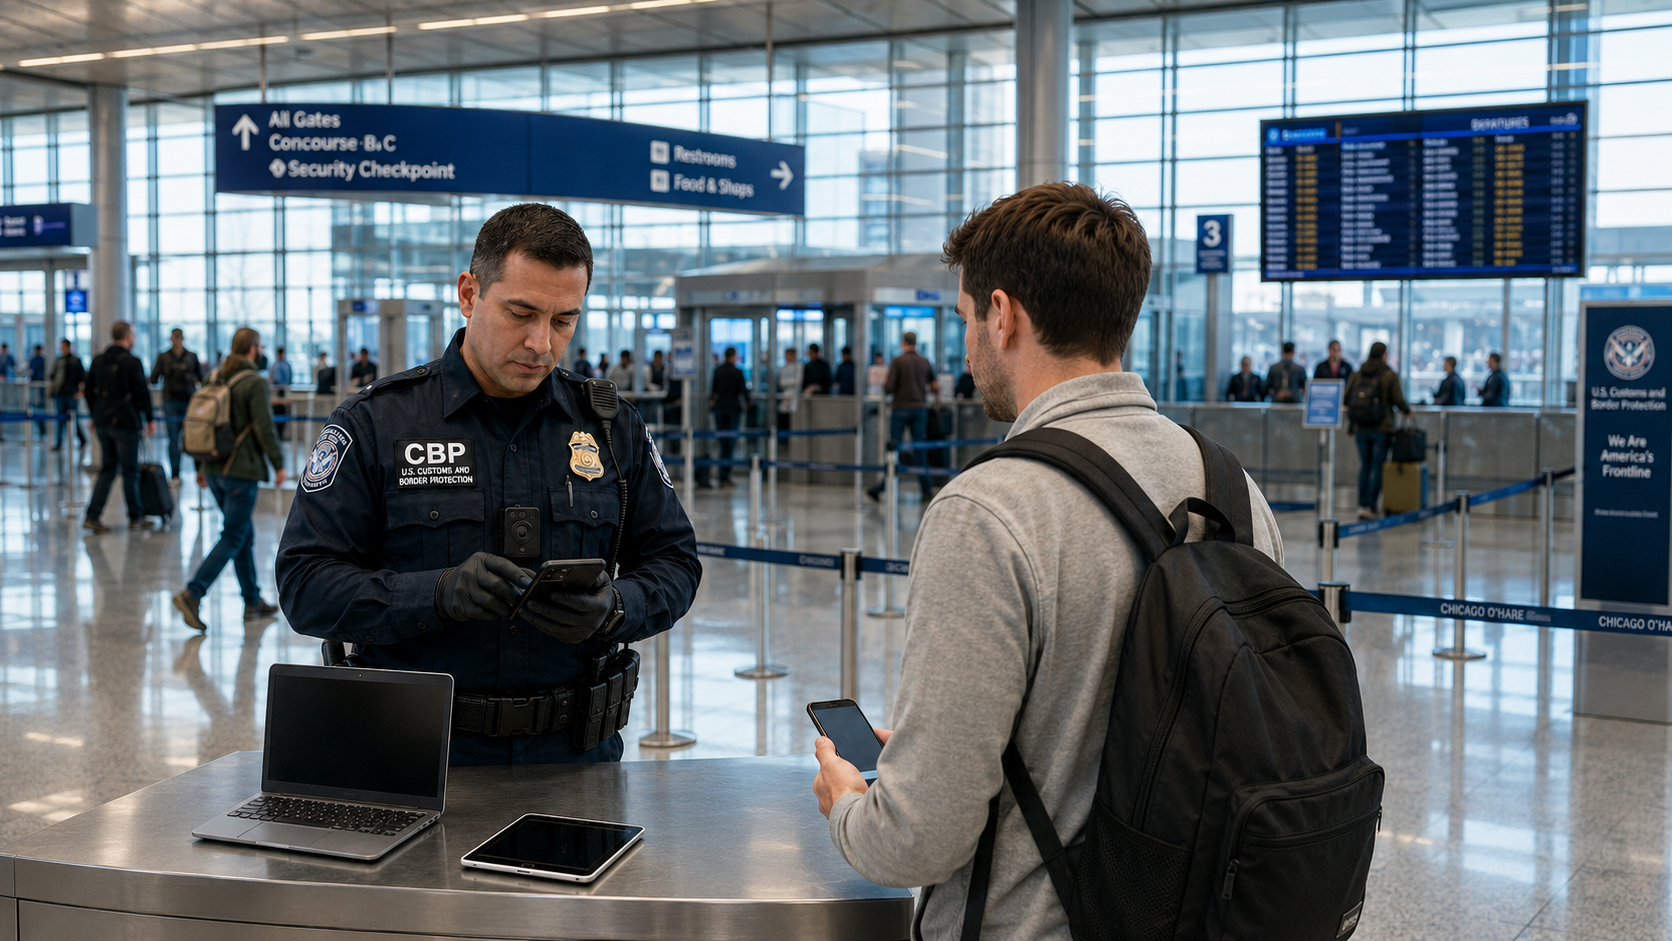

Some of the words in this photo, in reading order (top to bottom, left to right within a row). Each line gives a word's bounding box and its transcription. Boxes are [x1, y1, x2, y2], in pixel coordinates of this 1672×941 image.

[268, 110, 290, 128] All
[293, 110, 341, 129] Gates
[268, 133, 358, 152] Concourse
[674, 145, 737, 169] Restrooms
[287, 159, 356, 182] Security
[359, 160, 456, 182] Checkpoint
[707, 177, 717, 194] &
[1202, 219, 1222, 248] 3
[1609, 386, 1648, 398] Customs
[1648, 386, 1666, 399] and
[1590, 399, 1620, 411] Border
[1621, 399, 1667, 411] Protection
[1608, 434, 1626, 448] We
[1627, 434, 1647, 448] Are
[404, 442, 466, 465] CBP
[1599, 449, 1654, 463] America's
[401, 467, 416, 477] U.S.
[417, 466, 453, 476] CUSTOMS
[1602, 464, 1652, 479] Frontline
[1440, 602, 1485, 618] CHICAGO
[1487, 606, 1525, 621] O'HARE
[1598, 615, 1646, 630] CHICAGO
